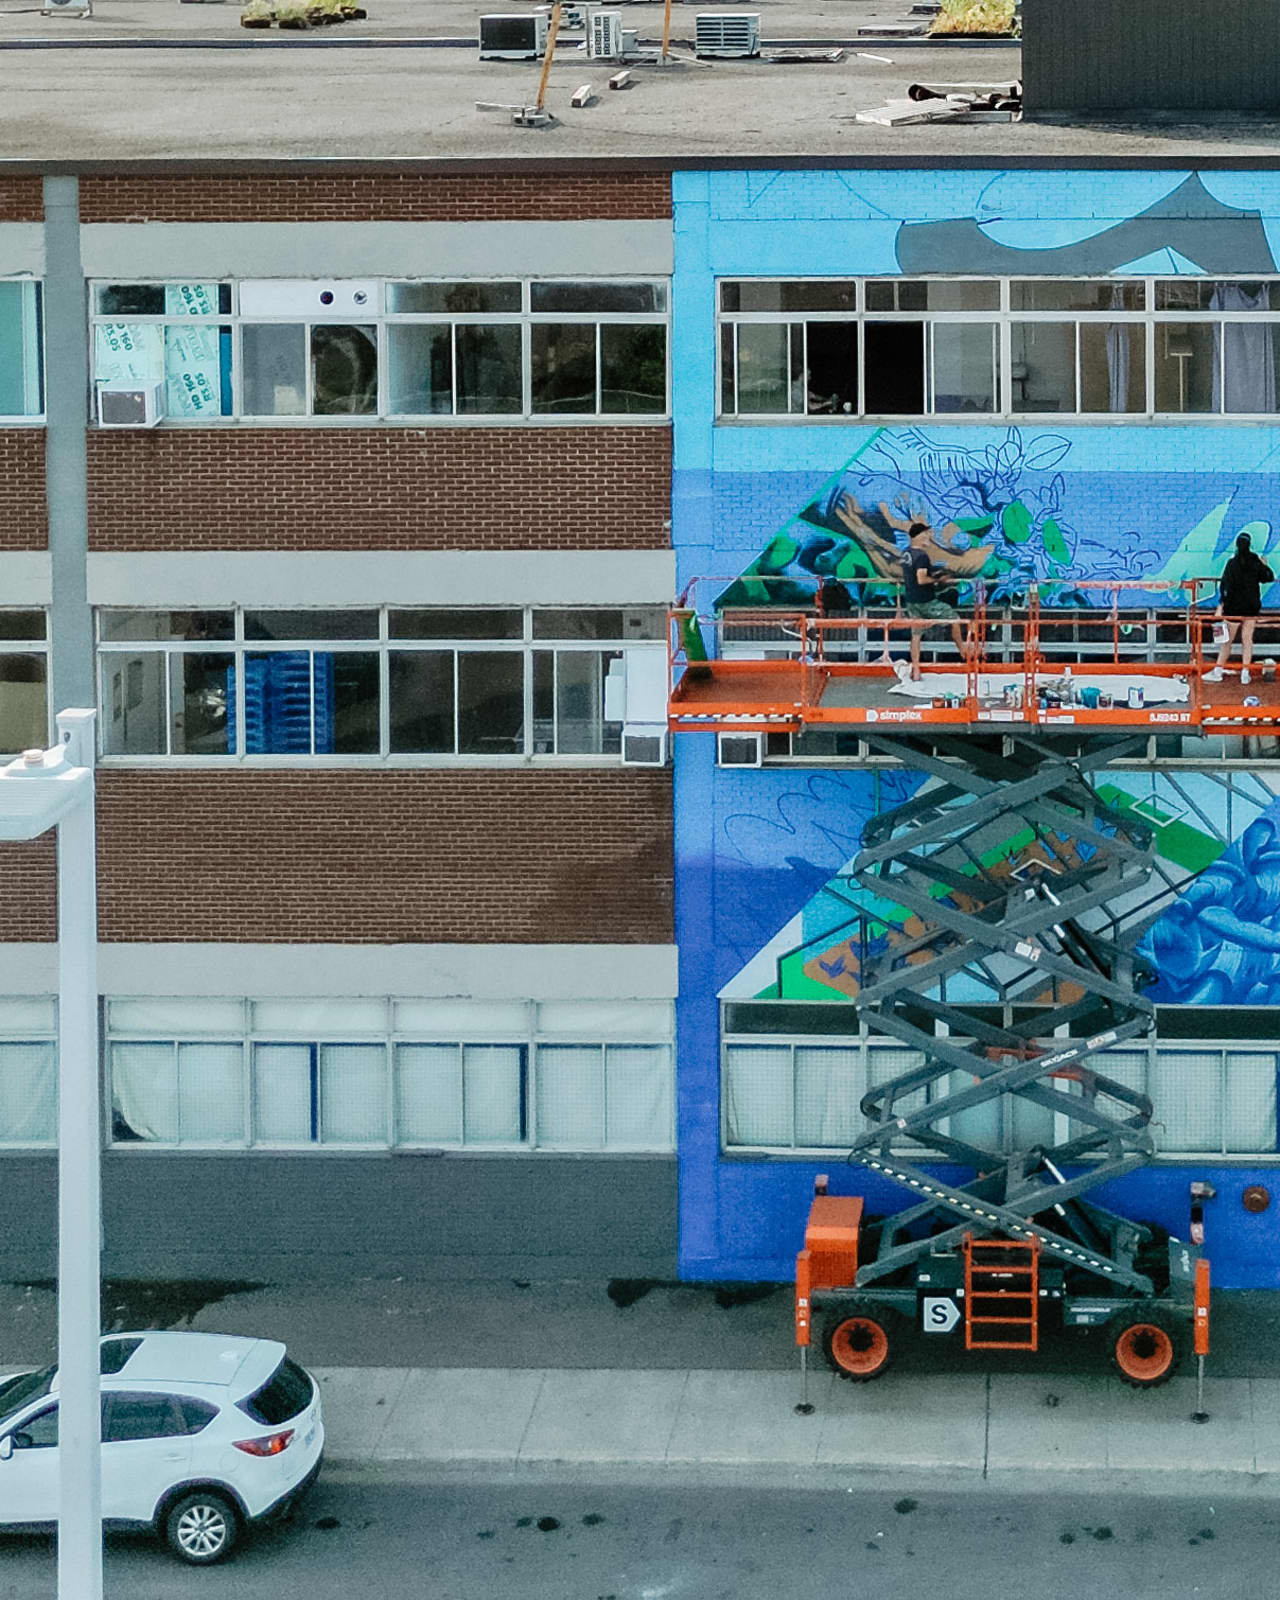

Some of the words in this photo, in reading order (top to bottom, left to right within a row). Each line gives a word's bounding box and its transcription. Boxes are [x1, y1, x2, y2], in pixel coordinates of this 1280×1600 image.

[120, 331, 133, 351] 160
[880, 710, 922, 722] simplex
[931, 1304, 948, 1324] S
